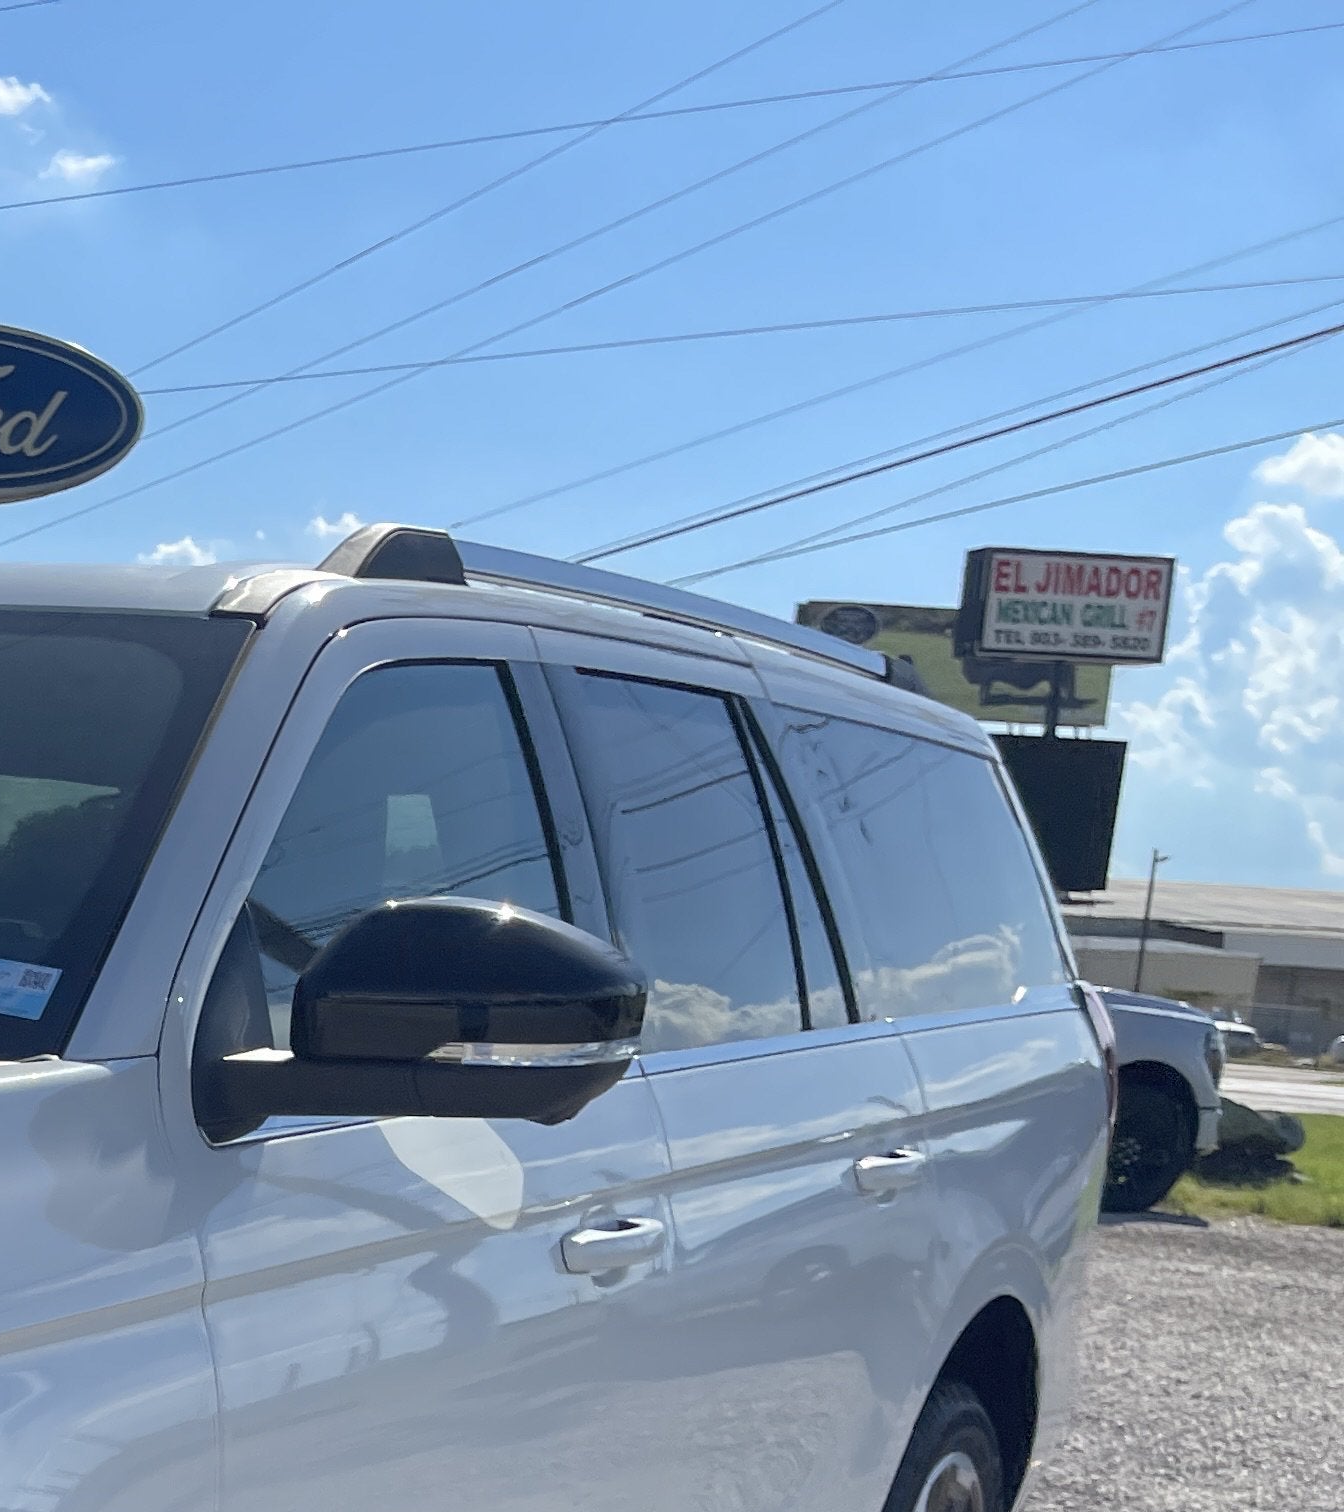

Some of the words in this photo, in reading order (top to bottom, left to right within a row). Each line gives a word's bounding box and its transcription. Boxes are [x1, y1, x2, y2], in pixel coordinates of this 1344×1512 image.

[994, 560, 1029, 593] EL
[1035, 562, 1164, 600] JIMADOR
[996, 599, 1073, 624] MEXICAN
[1079, 604, 1129, 628] GRILL
